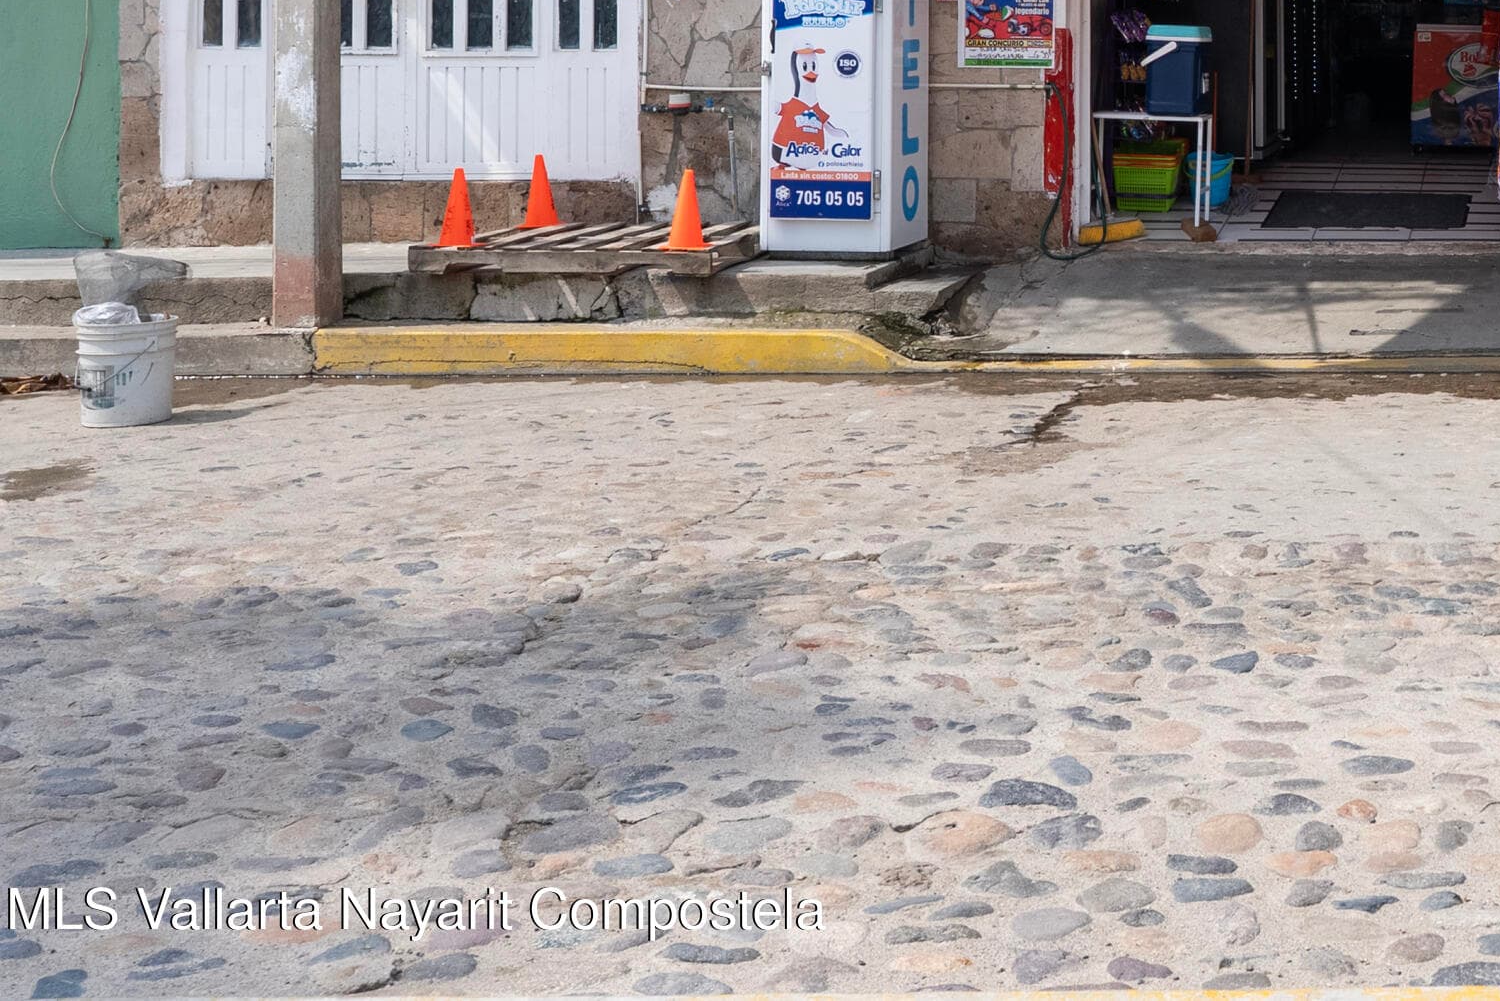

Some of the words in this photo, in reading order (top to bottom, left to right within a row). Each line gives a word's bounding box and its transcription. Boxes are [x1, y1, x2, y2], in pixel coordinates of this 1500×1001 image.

[988, 40, 1025, 48] CONCURSO
[839, 59, 857, 67] ISO
[831, 143, 862, 158] Calor
[796, 190, 821, 205] 705
[825, 191, 843, 206] 05
[847, 191, 864, 206] 05
